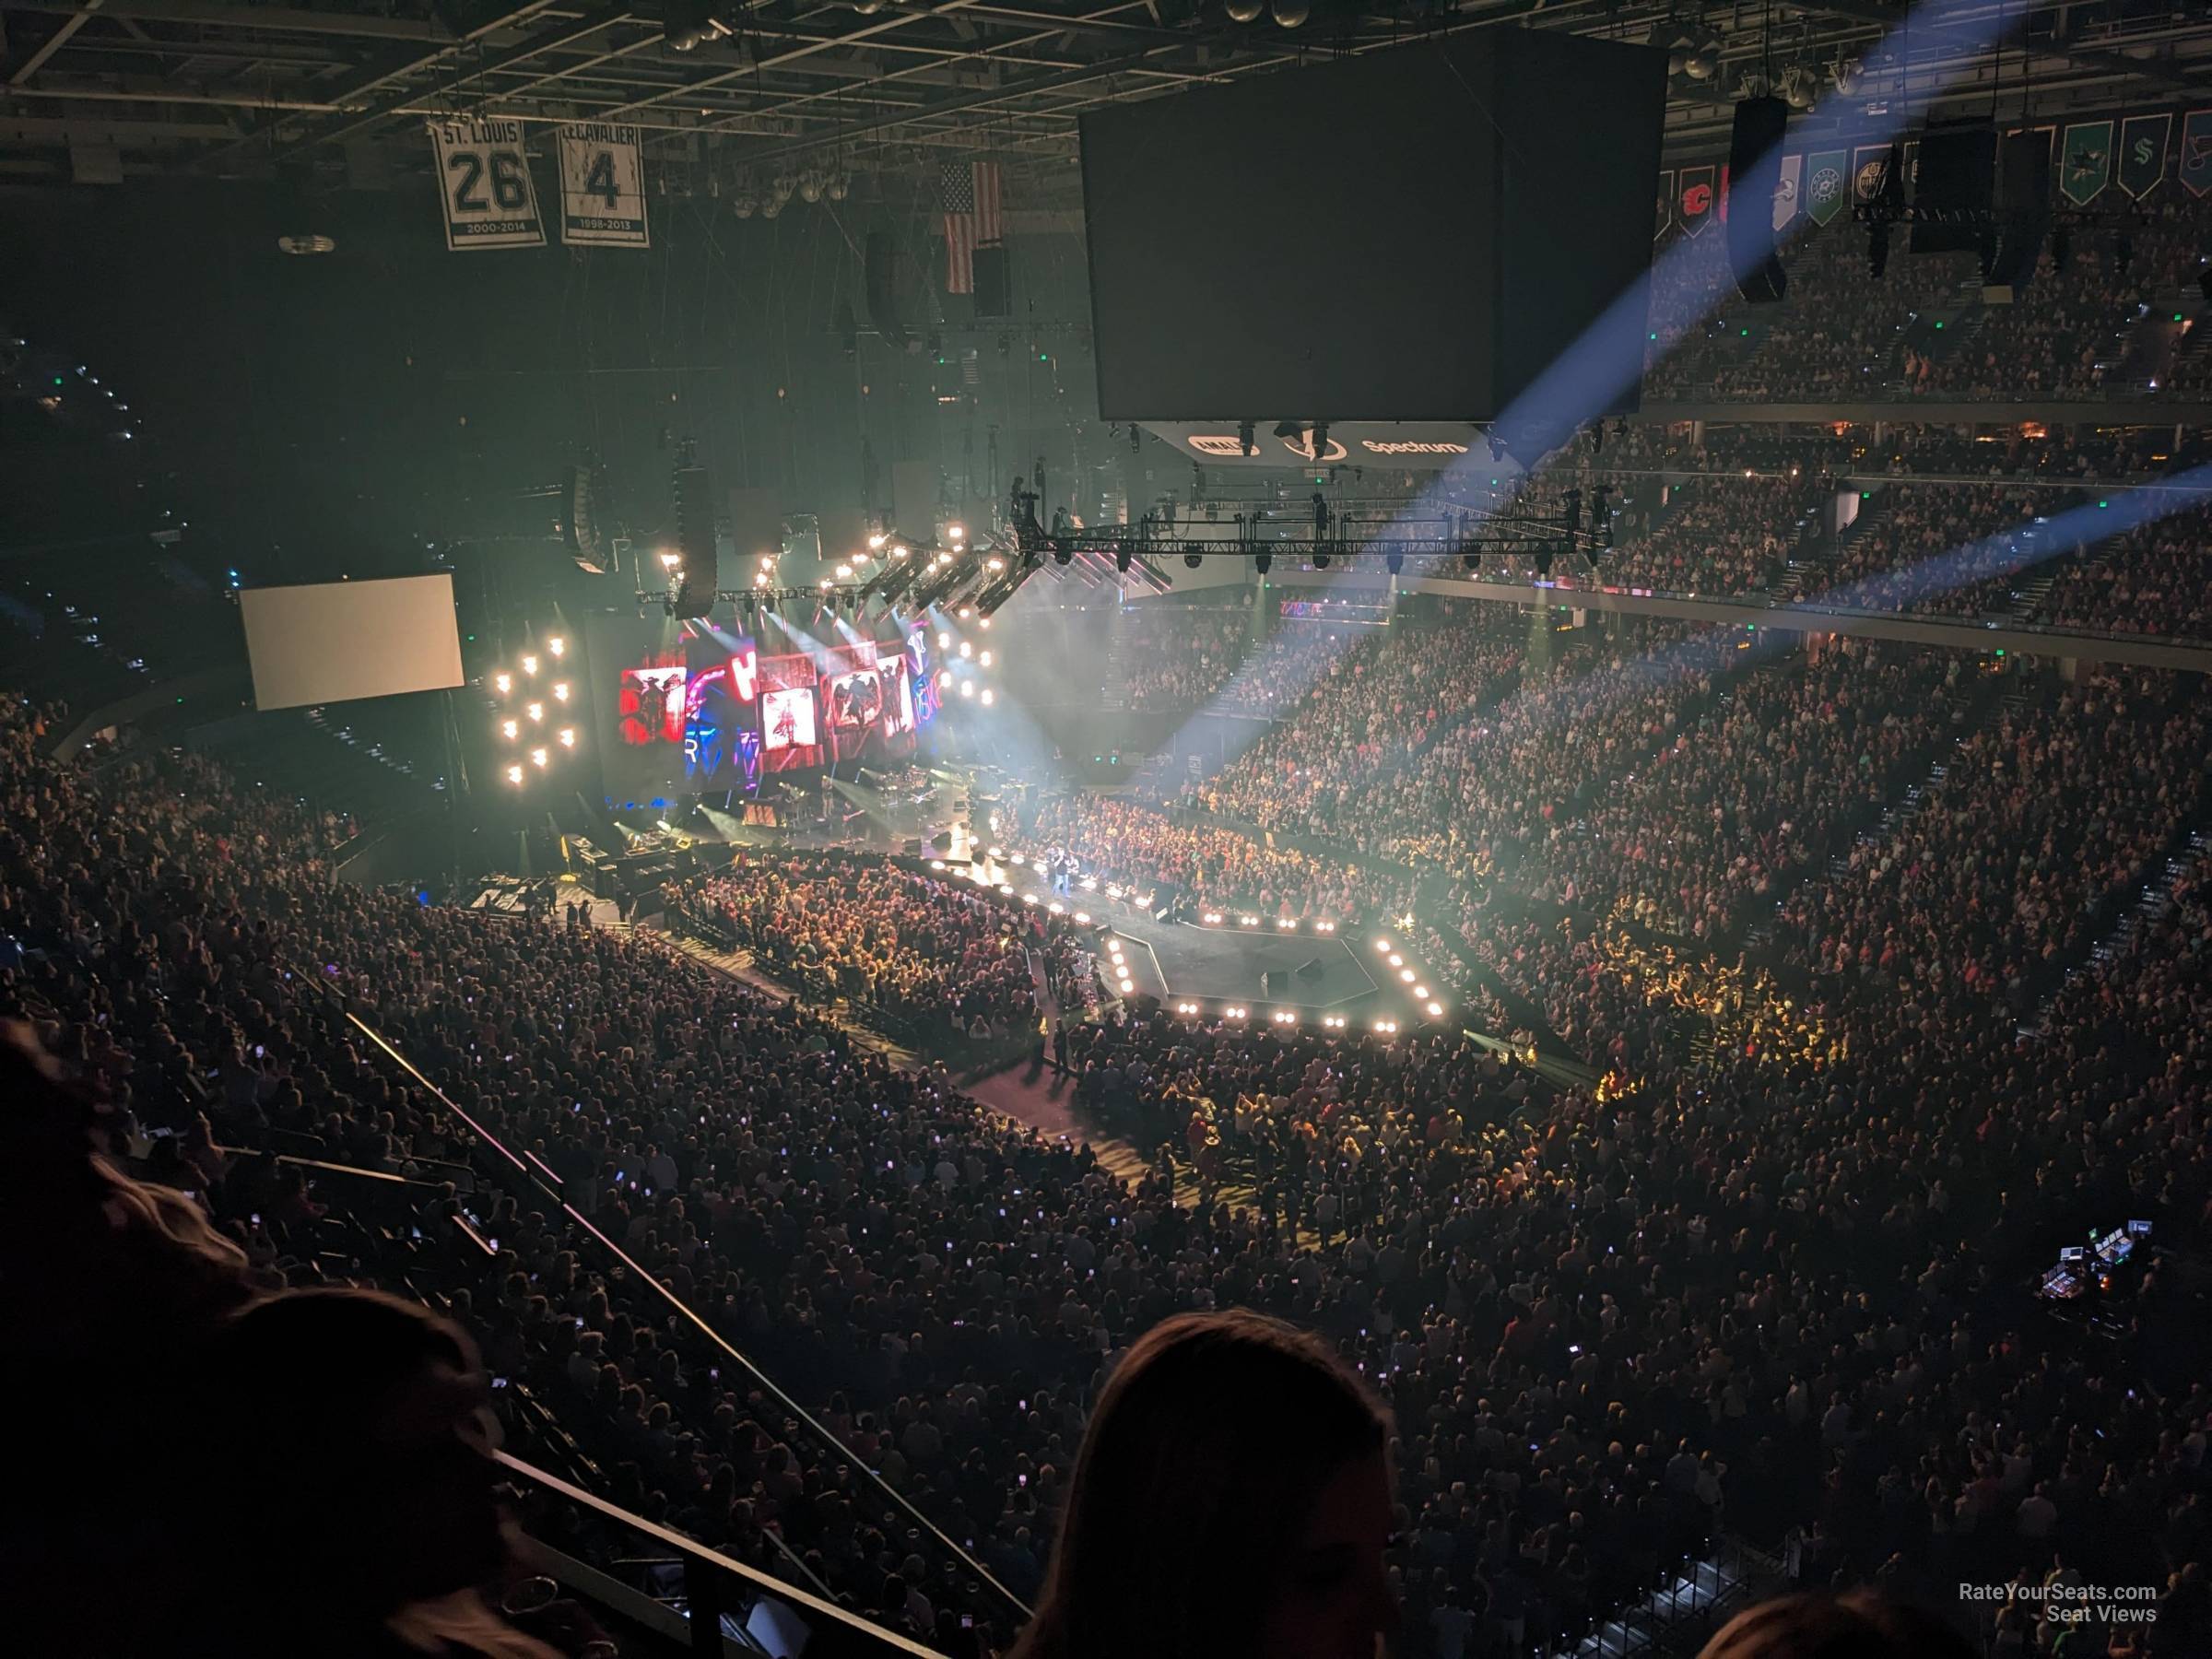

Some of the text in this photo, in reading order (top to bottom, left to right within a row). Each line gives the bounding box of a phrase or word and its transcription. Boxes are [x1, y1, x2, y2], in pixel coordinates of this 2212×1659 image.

[443, 122, 518, 145] ST. LOUIS
[448, 150, 529, 213] 26
[587, 151, 620, 210] 4
[467, 222, 526, 233] 2000-2014
[581, 218, 631, 230] 1998-2013
[1362, 441, 1468, 454] Spectrum
